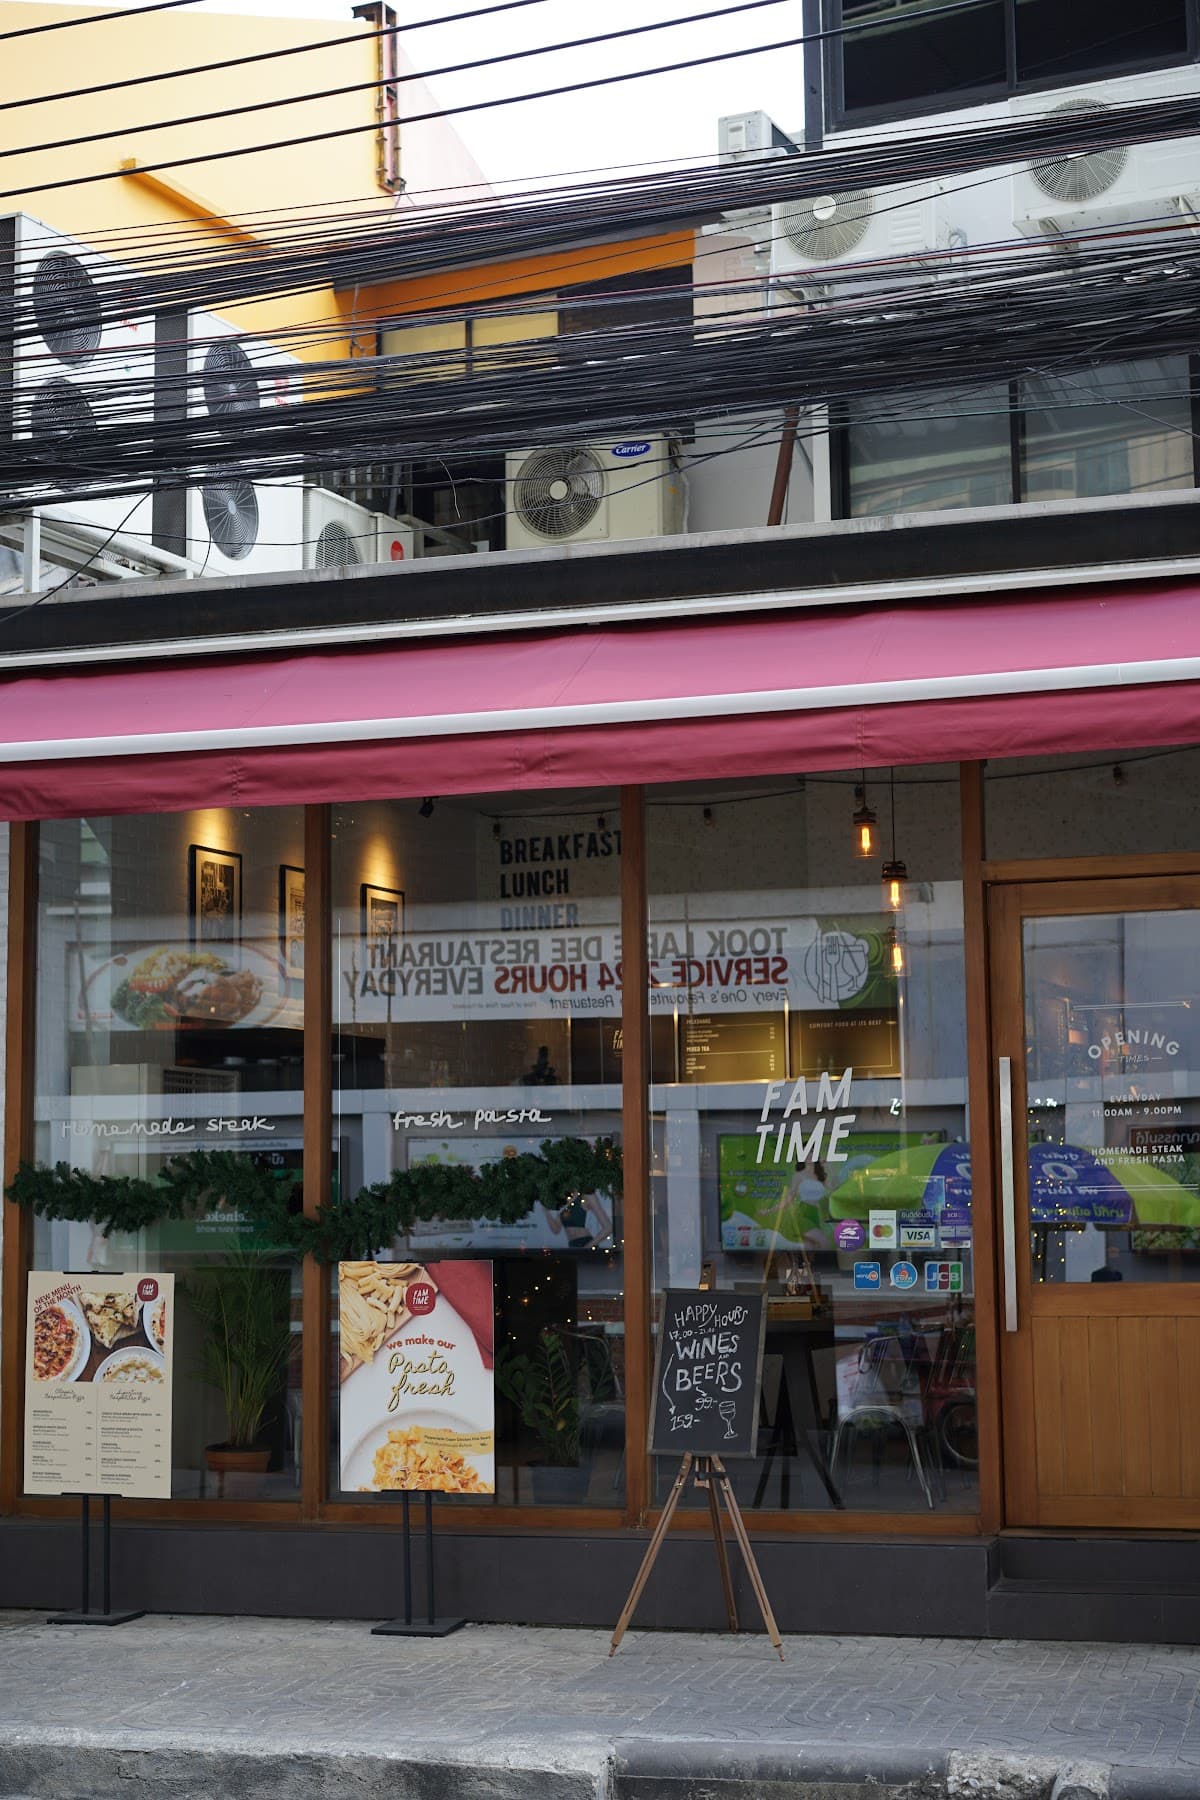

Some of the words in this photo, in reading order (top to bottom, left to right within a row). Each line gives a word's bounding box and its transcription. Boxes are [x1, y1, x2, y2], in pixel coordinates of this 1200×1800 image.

[616, 444, 646, 454] Carrier
[500, 831, 621, 865] BREAKFAST
[500, 868, 569, 898] LUNCH
[500, 903, 579, 931] DINNER
[1087, 1029, 1180, 1059] OPENING
[760, 1067, 853, 1122] FAM
[1110, 1093, 1161, 1103] EVERYDAY
[392, 1109, 463, 1130] fresh
[474, 1109, 552, 1130] pasta
[1092, 1107, 1133, 1118] 11.00AM
[1143, 1106, 1182, 1115] 9.00PM
[205, 1116, 275, 1133] steak
[756, 1114, 856, 1164] TIME
[1091, 1145, 1148, 1156] HOMEMADE
[1152, 1144, 1184, 1153] STEAK
[1093, 1156, 1115, 1166] AND
[1118, 1155, 1149, 1164] FRESH
[1152, 1154, 1186, 1164] PASTA
[906, 1231, 931, 1240] VISA
[927, 1272, 960, 1281] JCB
[34, 1292, 50, 1305] NEW
[51, 1282, 71, 1297] MENU
[43, 1298, 57, 1307] THE
[56, 1284, 82, 1302] MONTH
[412, 1296, 430, 1305] TIME
[413, 1288, 429, 1298] FAM
[674, 1303, 718, 1328] HAPPY
[714, 1305, 749, 1327] HOURS
[386, 1340, 403, 1350] we
[405, 1333, 435, 1345] make
[437, 1339, 456, 1350] our
[675, 1331, 741, 1361] WINES
[388, 1350, 450, 1374] Pasta
[675, 1361, 743, 1393] BEERS
[387, 1371, 456, 1413] fresh
